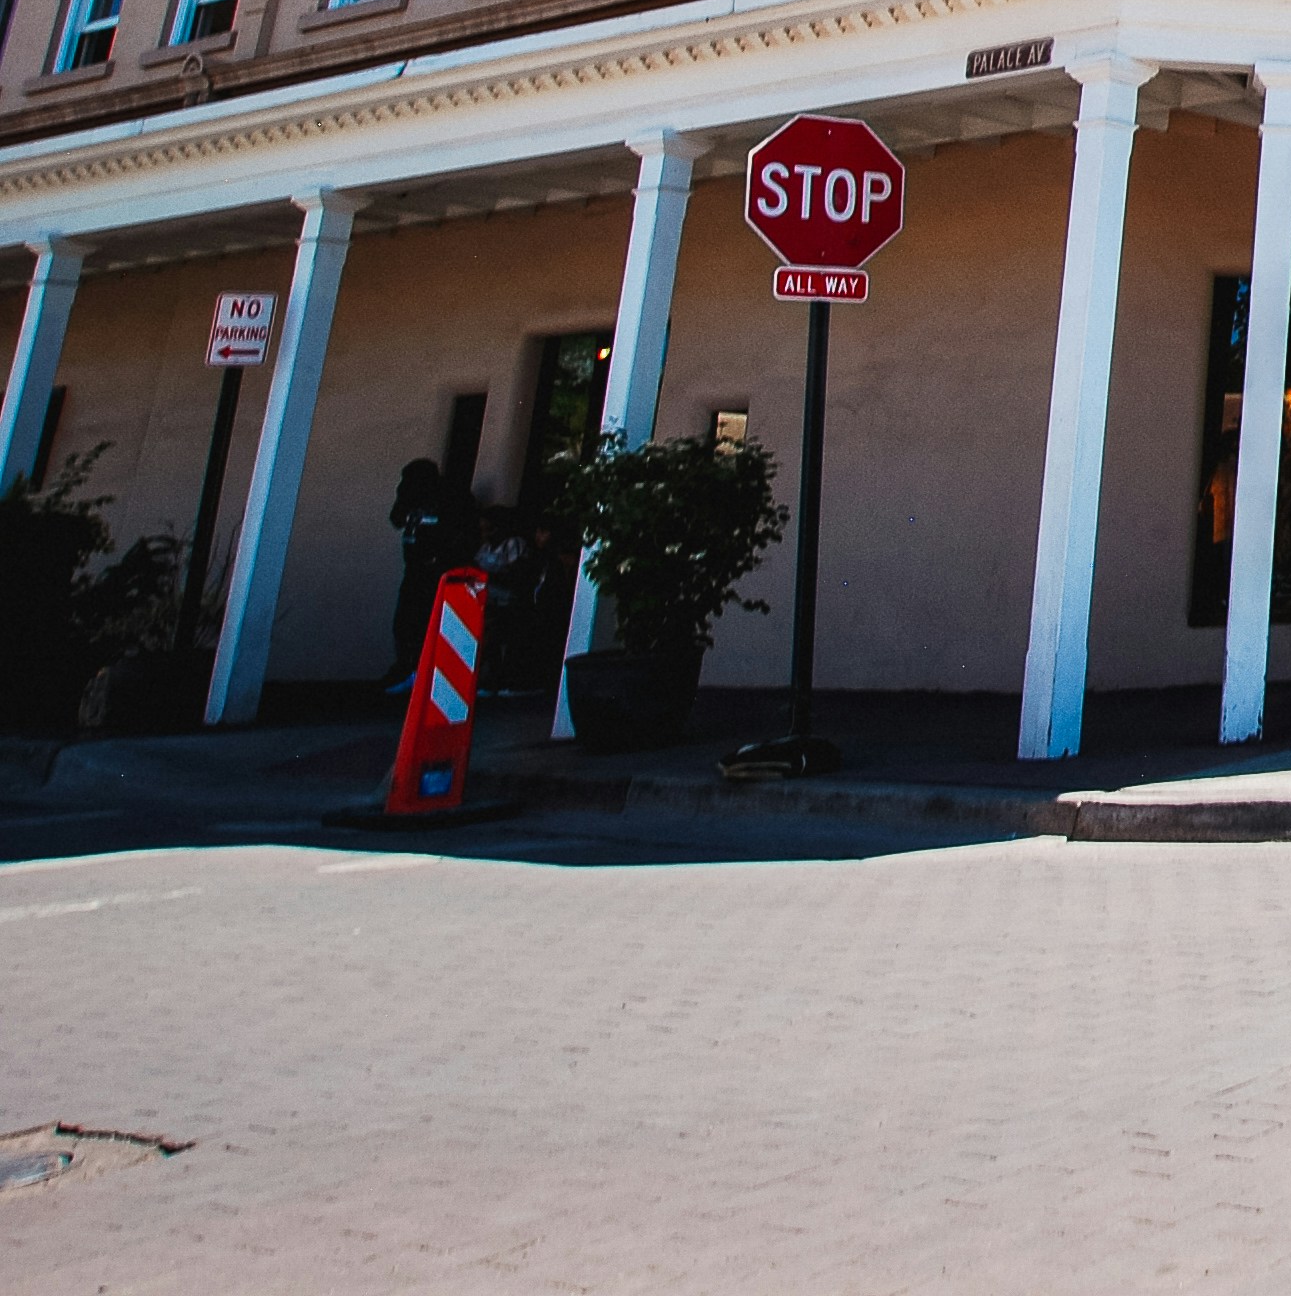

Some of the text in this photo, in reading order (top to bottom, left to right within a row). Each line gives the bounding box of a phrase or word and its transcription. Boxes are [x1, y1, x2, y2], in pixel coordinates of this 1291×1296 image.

[972, 40, 1047, 75] PALACE AV
[757, 161, 892, 224] STOP
[784, 274, 859, 295] ALL WAY
[230, 298, 262, 320] NO
[215, 325, 268, 341] PARKING
